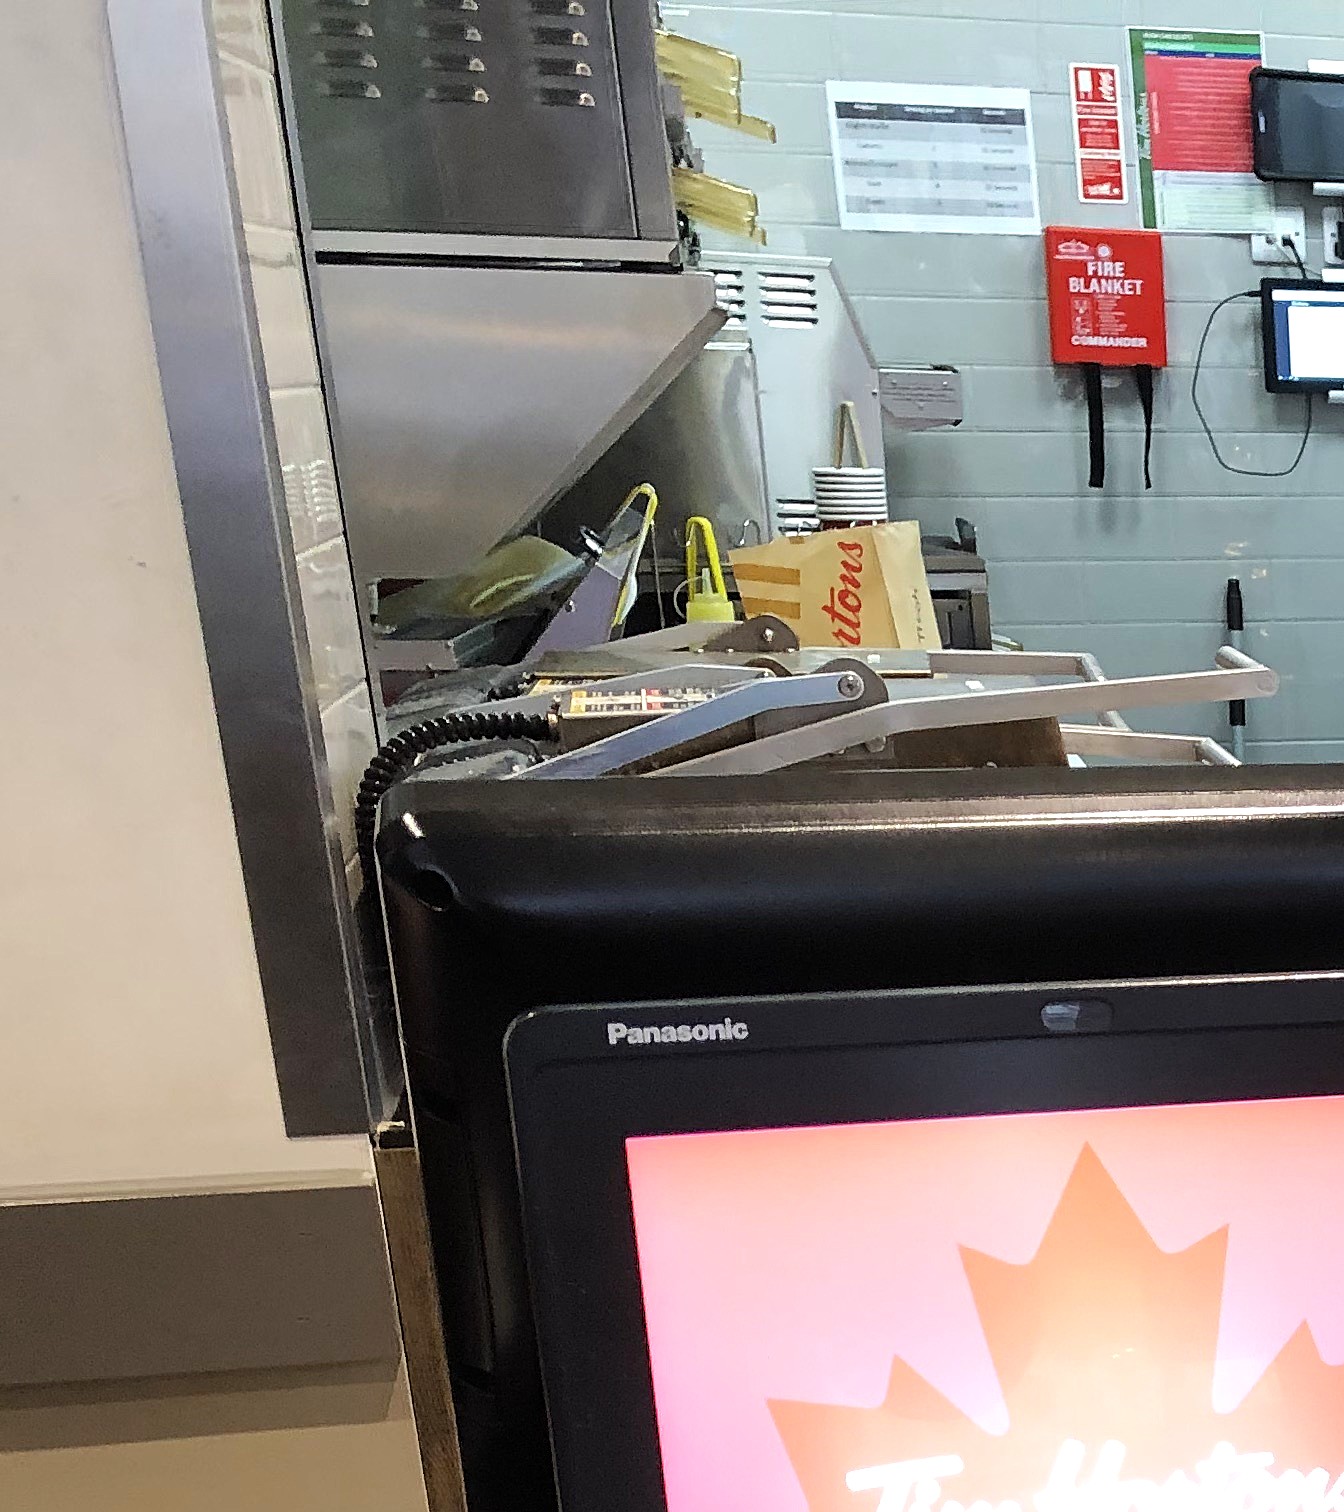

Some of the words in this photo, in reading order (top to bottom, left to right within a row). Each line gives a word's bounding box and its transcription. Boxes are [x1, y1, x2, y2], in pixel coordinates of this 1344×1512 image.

[1086, 261, 1125, 277] FIRE
[1068, 277, 1144, 295] BLANKET
[1071, 335, 1147, 348] COMMANDER
[821, 541, 864, 647] rtons
[606, 1017, 749, 1045] Panasonic
